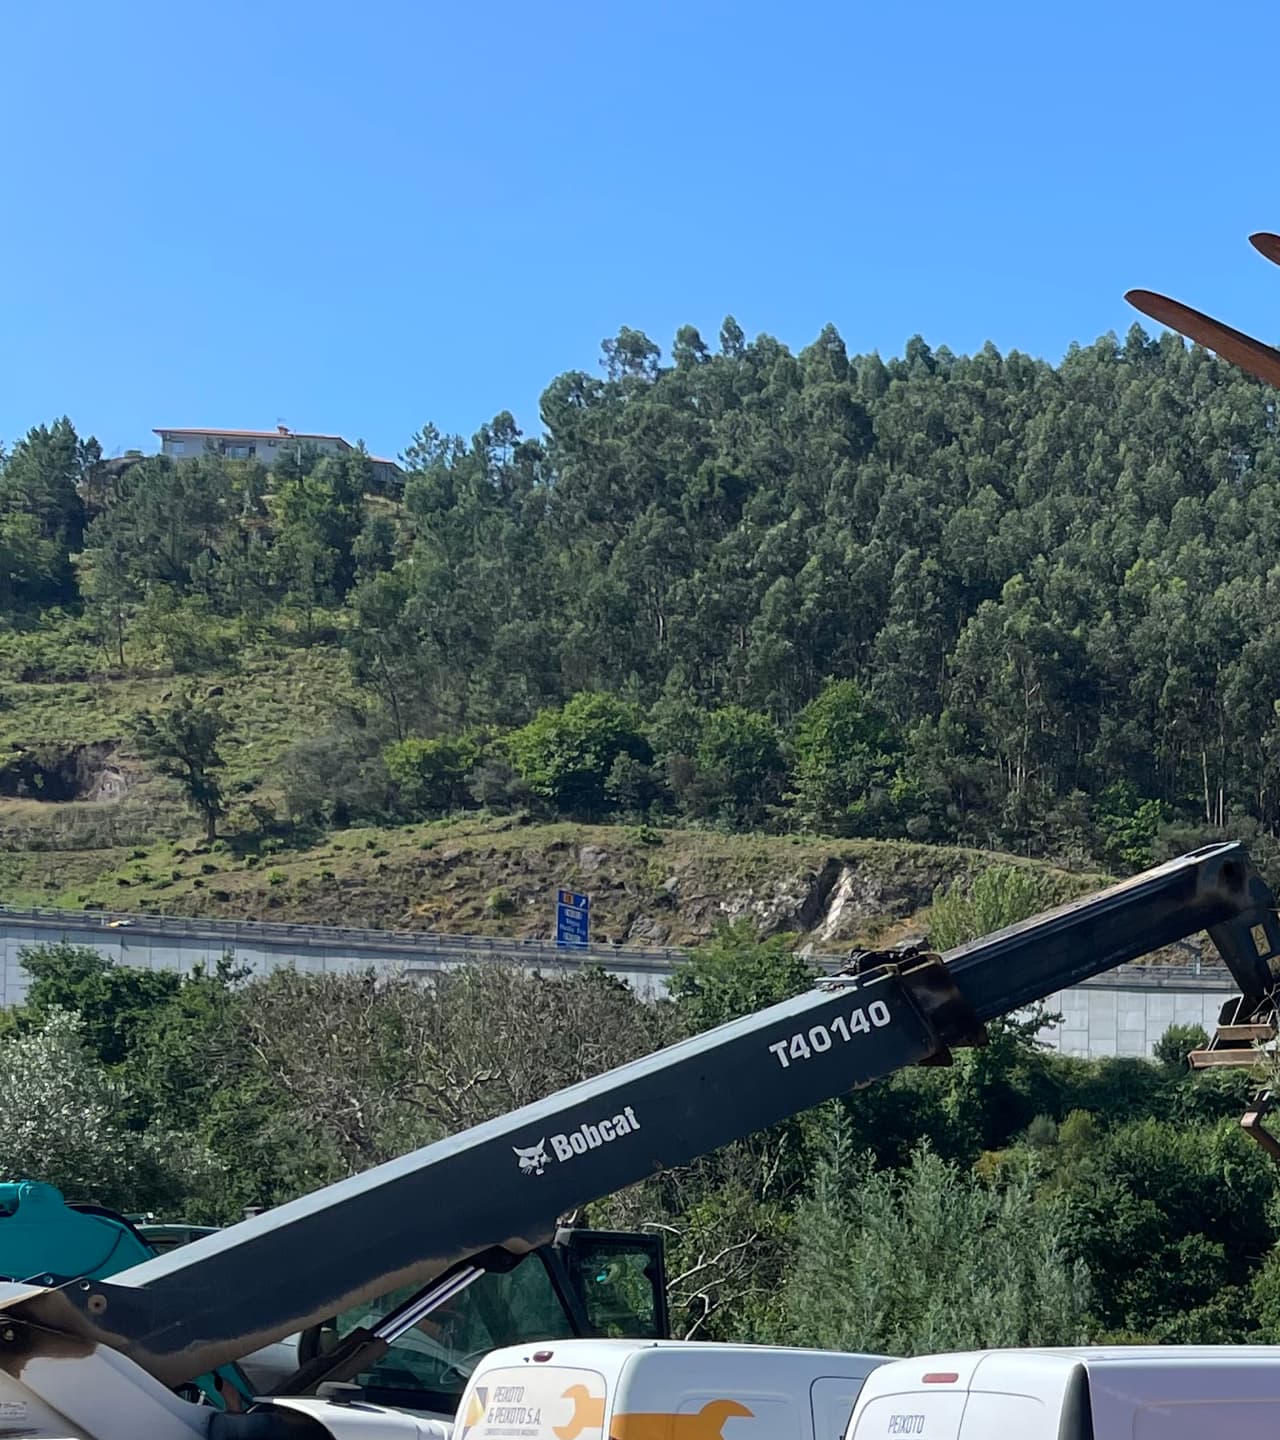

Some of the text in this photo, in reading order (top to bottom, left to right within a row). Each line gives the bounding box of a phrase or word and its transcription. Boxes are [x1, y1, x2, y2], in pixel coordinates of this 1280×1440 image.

[768, 1000, 891, 1068] T40140
[551, 1106, 641, 1162] Bobcat
[493, 1386, 525, 1403] PEIXOTO
[494, 1407, 527, 1425] PEIXOTO
[888, 1415, 925, 1434] PEIXOTO
